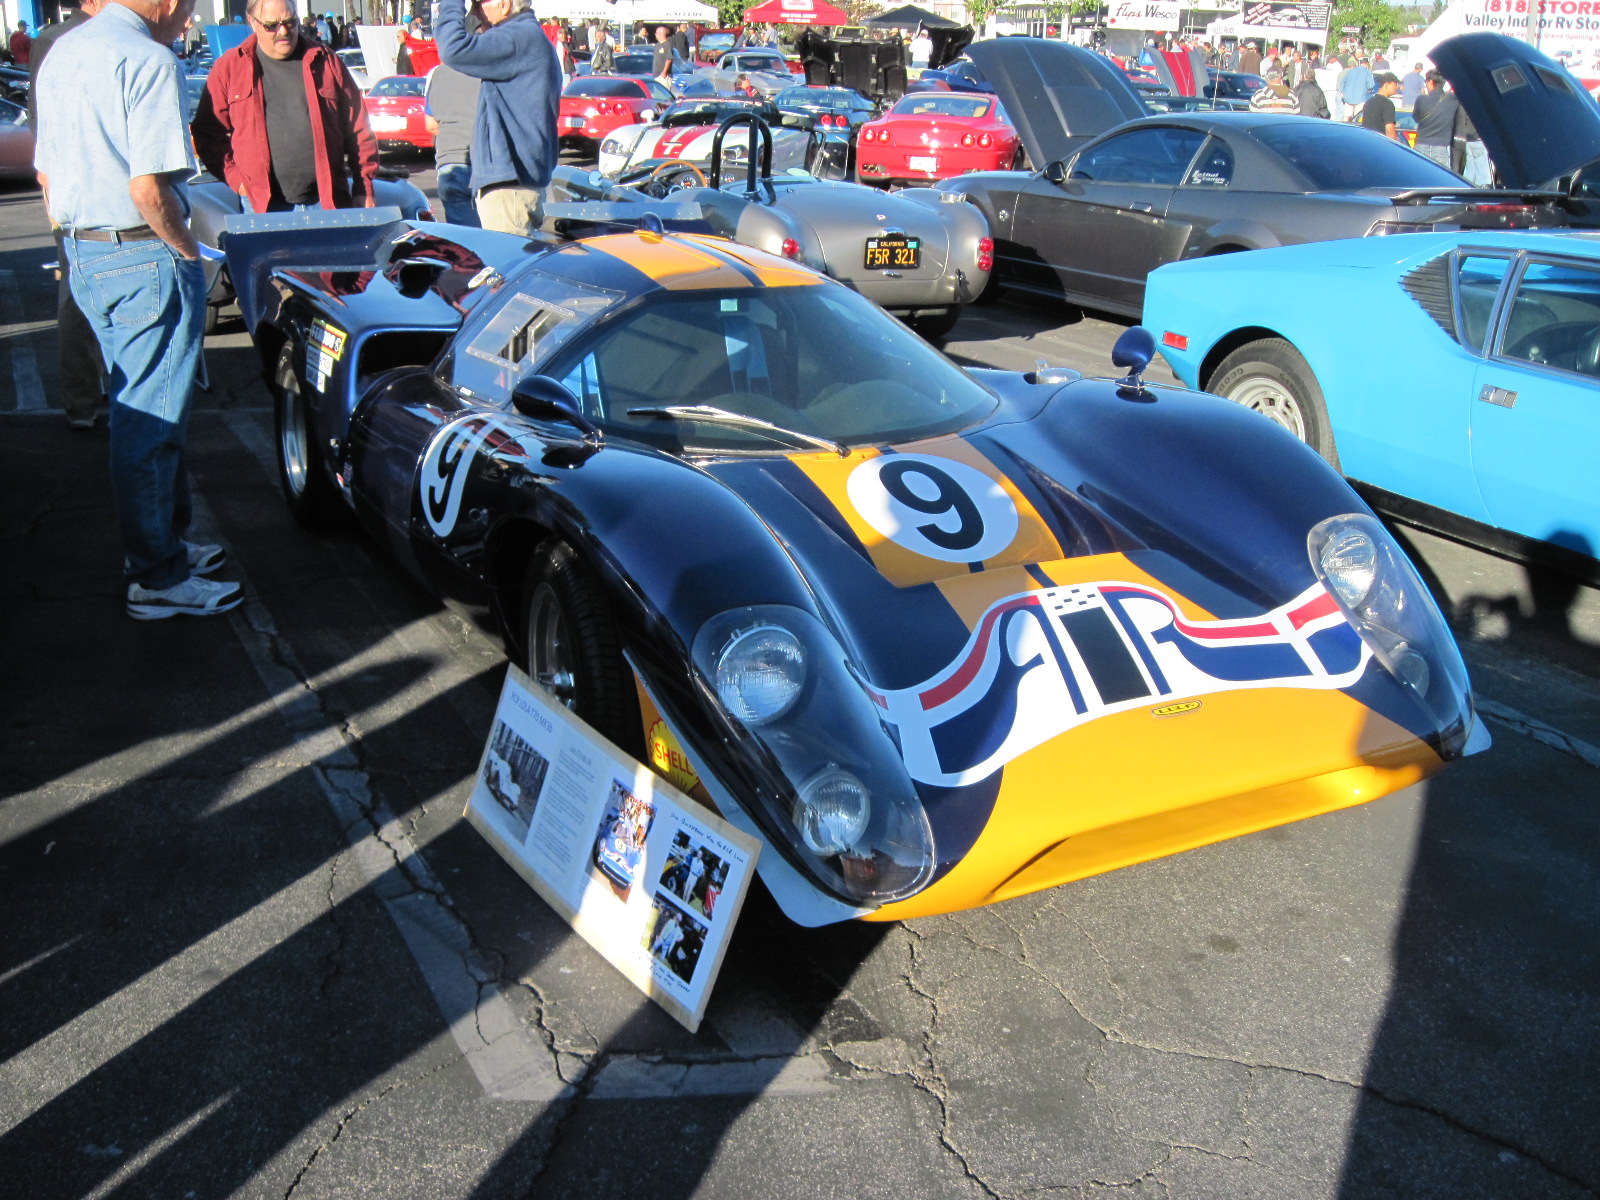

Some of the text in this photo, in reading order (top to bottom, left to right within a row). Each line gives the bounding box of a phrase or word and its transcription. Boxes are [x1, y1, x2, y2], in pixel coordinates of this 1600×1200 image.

[1116, 2, 1177, 20] Flip's Wesco
[1465, 14, 1600, 30] Valley Indor Rv Sto
[1565, 33, 1593, 41] Opening
[867, 248, 915, 264] F5R 321
[878, 459, 985, 550] 9
[655, 743, 694, 777] SHELL
